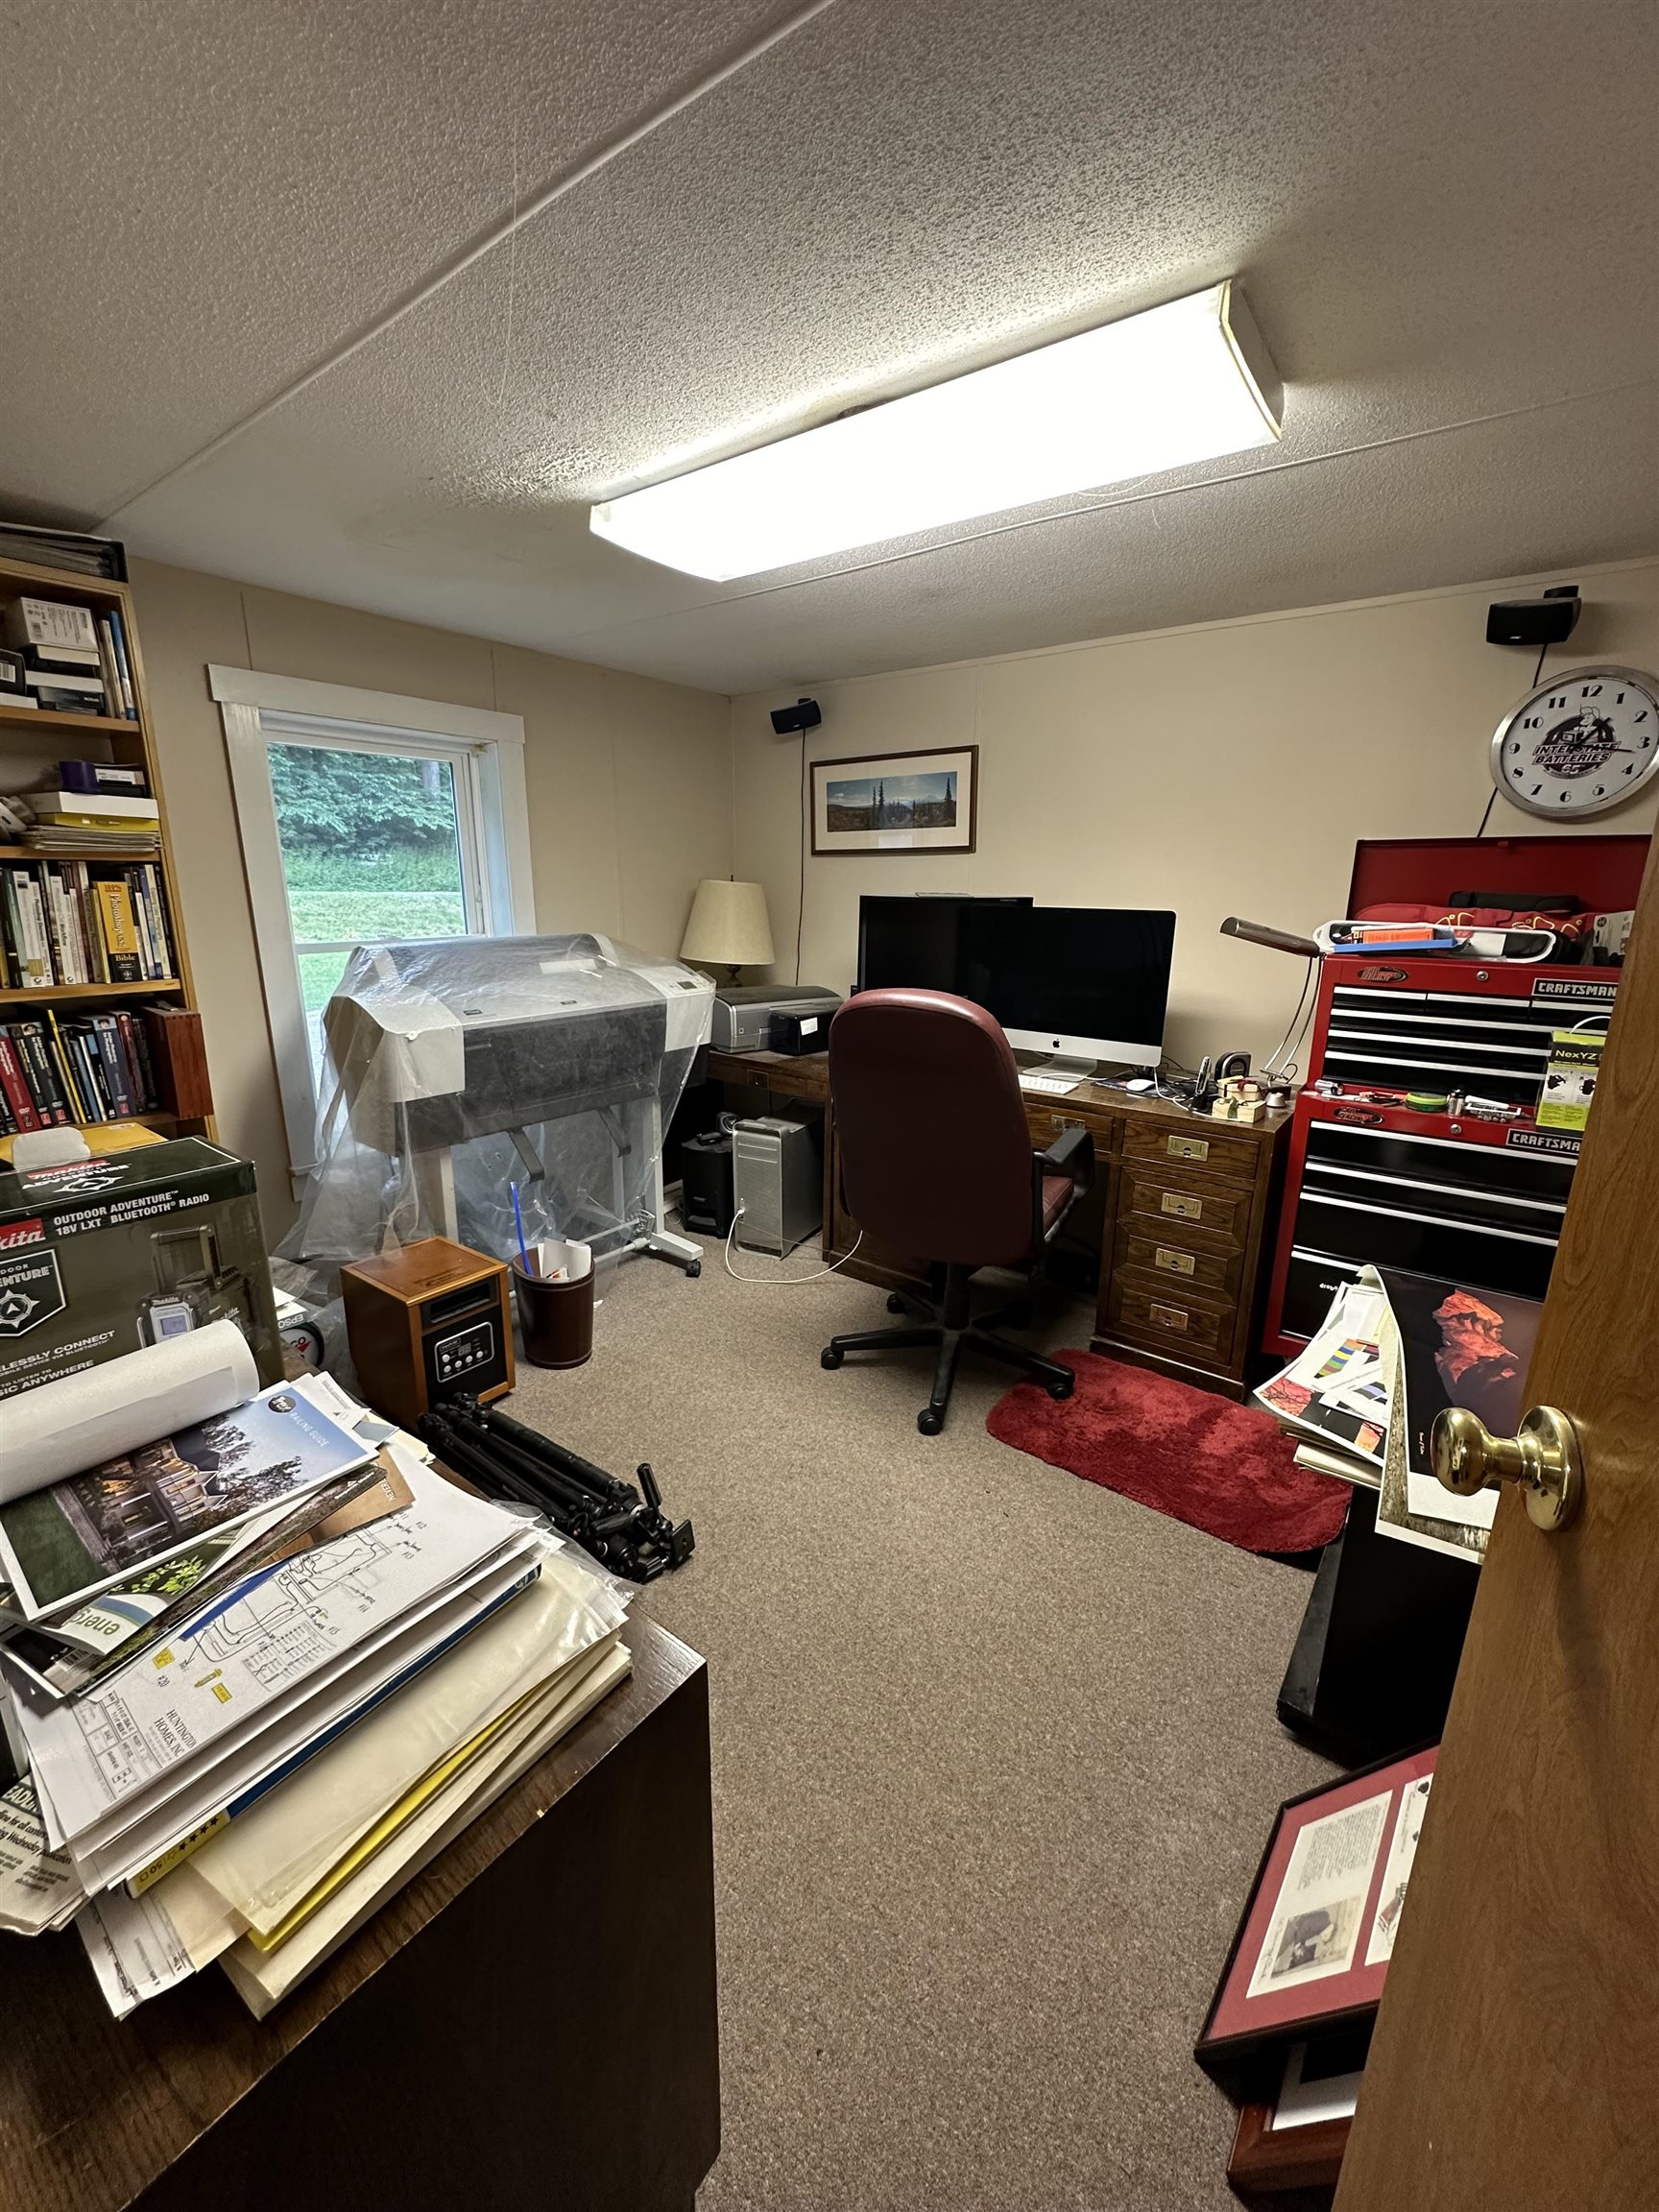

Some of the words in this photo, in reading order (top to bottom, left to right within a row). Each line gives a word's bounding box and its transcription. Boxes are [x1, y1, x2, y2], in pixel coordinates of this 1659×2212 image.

[1582, 685, 1602, 697] 12
[1549, 696, 1567, 709] 11
[1617, 692, 1624, 704] 1
[1524, 716, 1544, 729] 10
[1634, 710, 1648, 723] 2
[1509, 743, 1521, 754] 9
[1637, 736, 1650, 749] 3
[1536, 753, 1610, 763] BATTERIES
[1512, 767, 1524, 778] 8
[1622, 763, 1633, 775] 4
[1530, 784, 1543, 796] 7
[1593, 783, 1605, 796] 5
[1560, 791, 1572, 802] 6
[110, 893, 126, 935] Photoshop
[1538, 982, 1618, 997] CRAFTSMAN
[1555, 1049, 1598, 1060] NexYZ
[1512, 1133, 1581, 1151] CRAFTSMA
[54, 1207, 108, 1226] OUTDOOR
[56, 1223, 78, 1237] 18V
[81, 1218, 101, 1230] LXT
[179, 1193, 210, 1208] RADIO
[278, 1314, 304, 1329] EPSO
[54, 1330, 115, 1355] CONNECT
[23, 1358, 50, 1369] DEVICE
[12, 1372, 39, 1383] LISTEN
[21, 1359, 94, 1389] ANYWHERE
[272, 1396, 292, 1412] Trex
[291, 1412, 314, 1431] RAILING
[308, 1430, 330, 1447] GUIDE
[154, 1718, 177, 1748] HOMES,
[7, 1831, 43, 1857] Wednesday
[150, 1862, 165, 1874] 50
